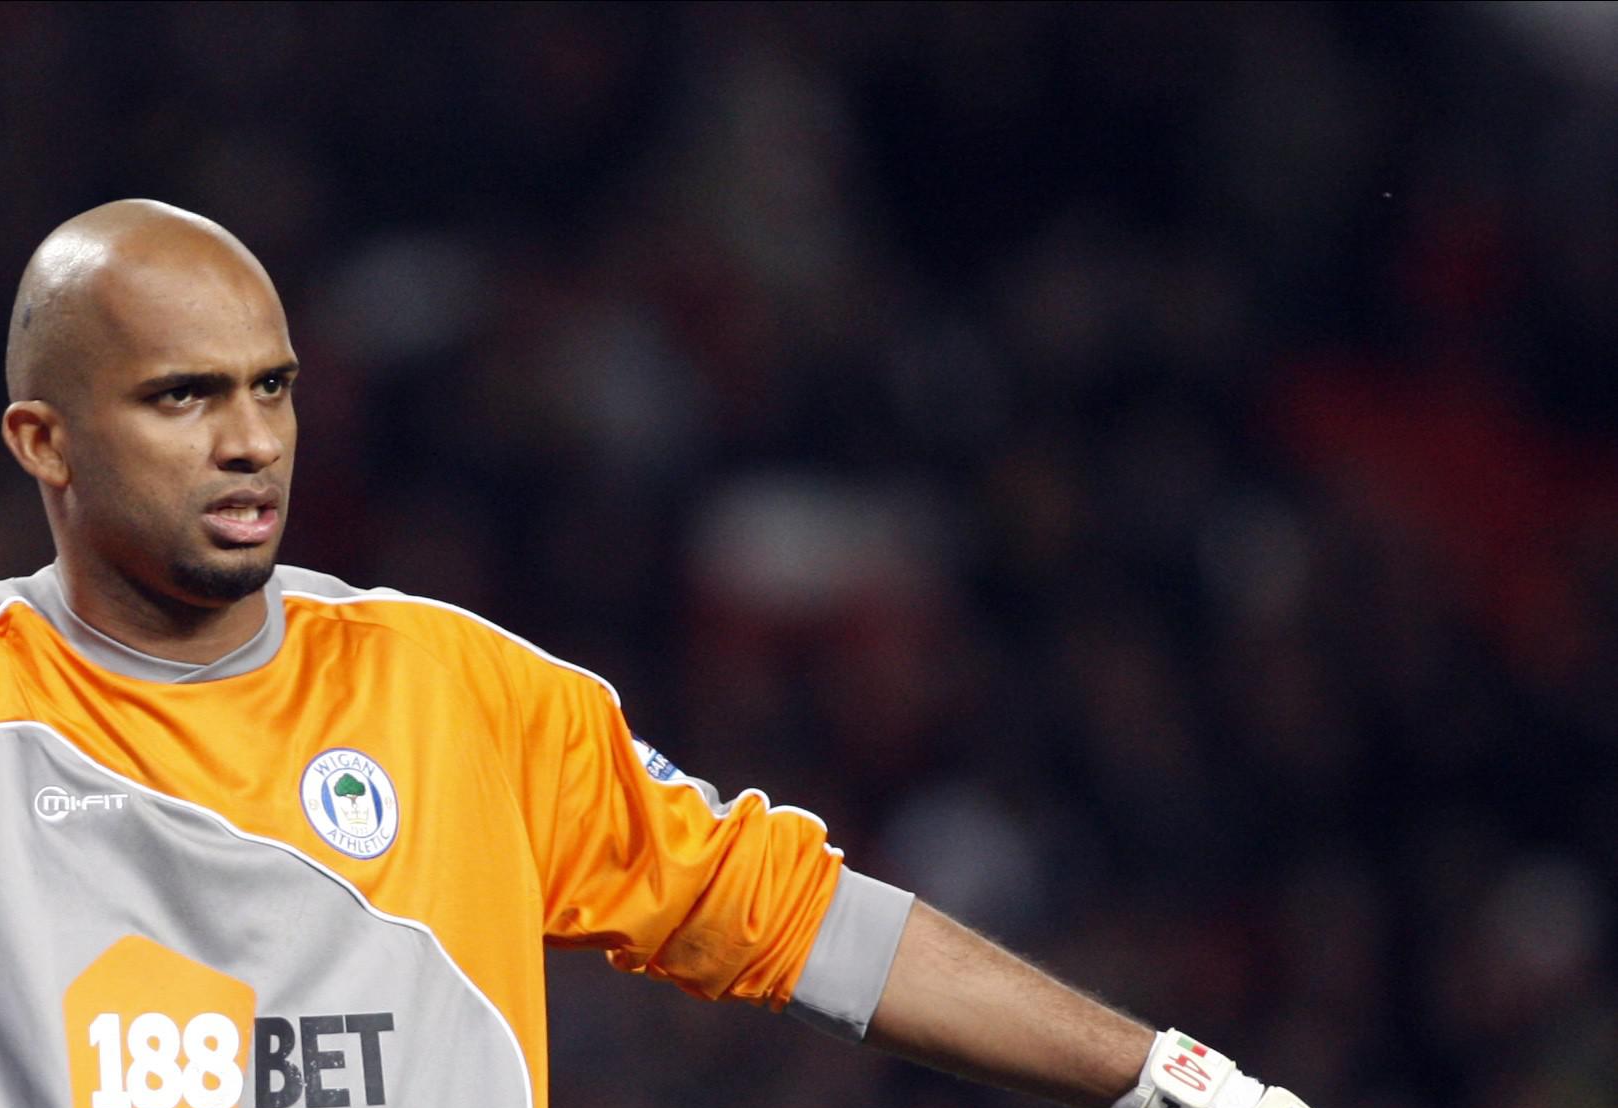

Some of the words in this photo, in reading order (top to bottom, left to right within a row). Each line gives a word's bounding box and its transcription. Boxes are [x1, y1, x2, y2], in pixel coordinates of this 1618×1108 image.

[313, 753, 376, 777] WIGAN
[326, 826, 390, 853] ATHLETIC
[1163, 1053, 1212, 1092] 40
